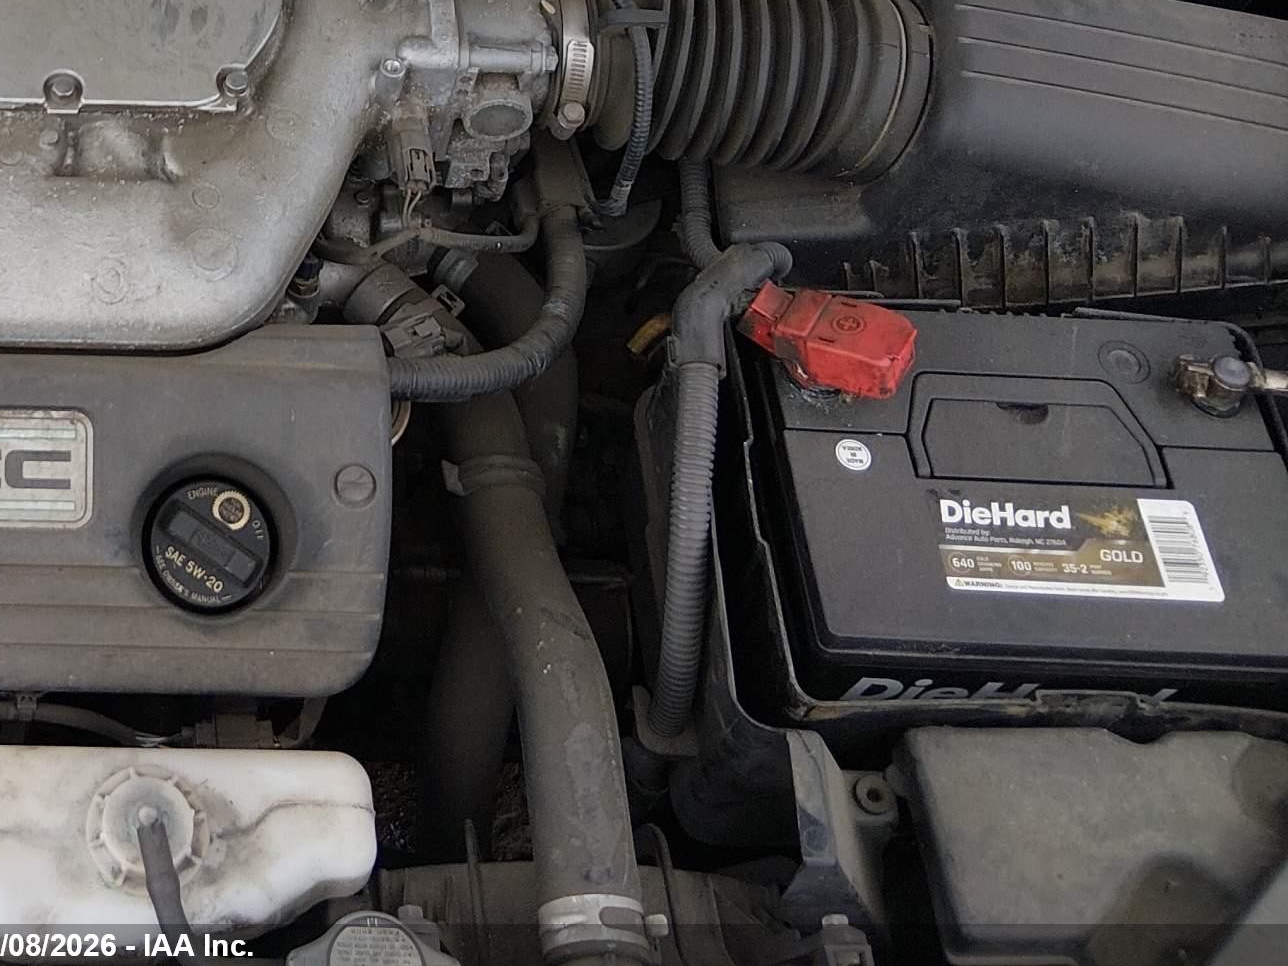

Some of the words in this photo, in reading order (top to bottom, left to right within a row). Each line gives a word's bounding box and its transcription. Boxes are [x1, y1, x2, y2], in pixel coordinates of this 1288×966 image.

[187, 487, 218, 500] ENGINE
[252, 520, 264, 539] OIL
[939, 499, 1072, 529] DieHard
[945, 527, 979, 535] Distributed
[165, 546, 186, 566] SAE
[1099, 549, 1144, 563] GOLD
[952, 557, 975, 569] 640
[1011, 560, 1032, 571] 100
[1062, 563, 1089, 574] 35-2
